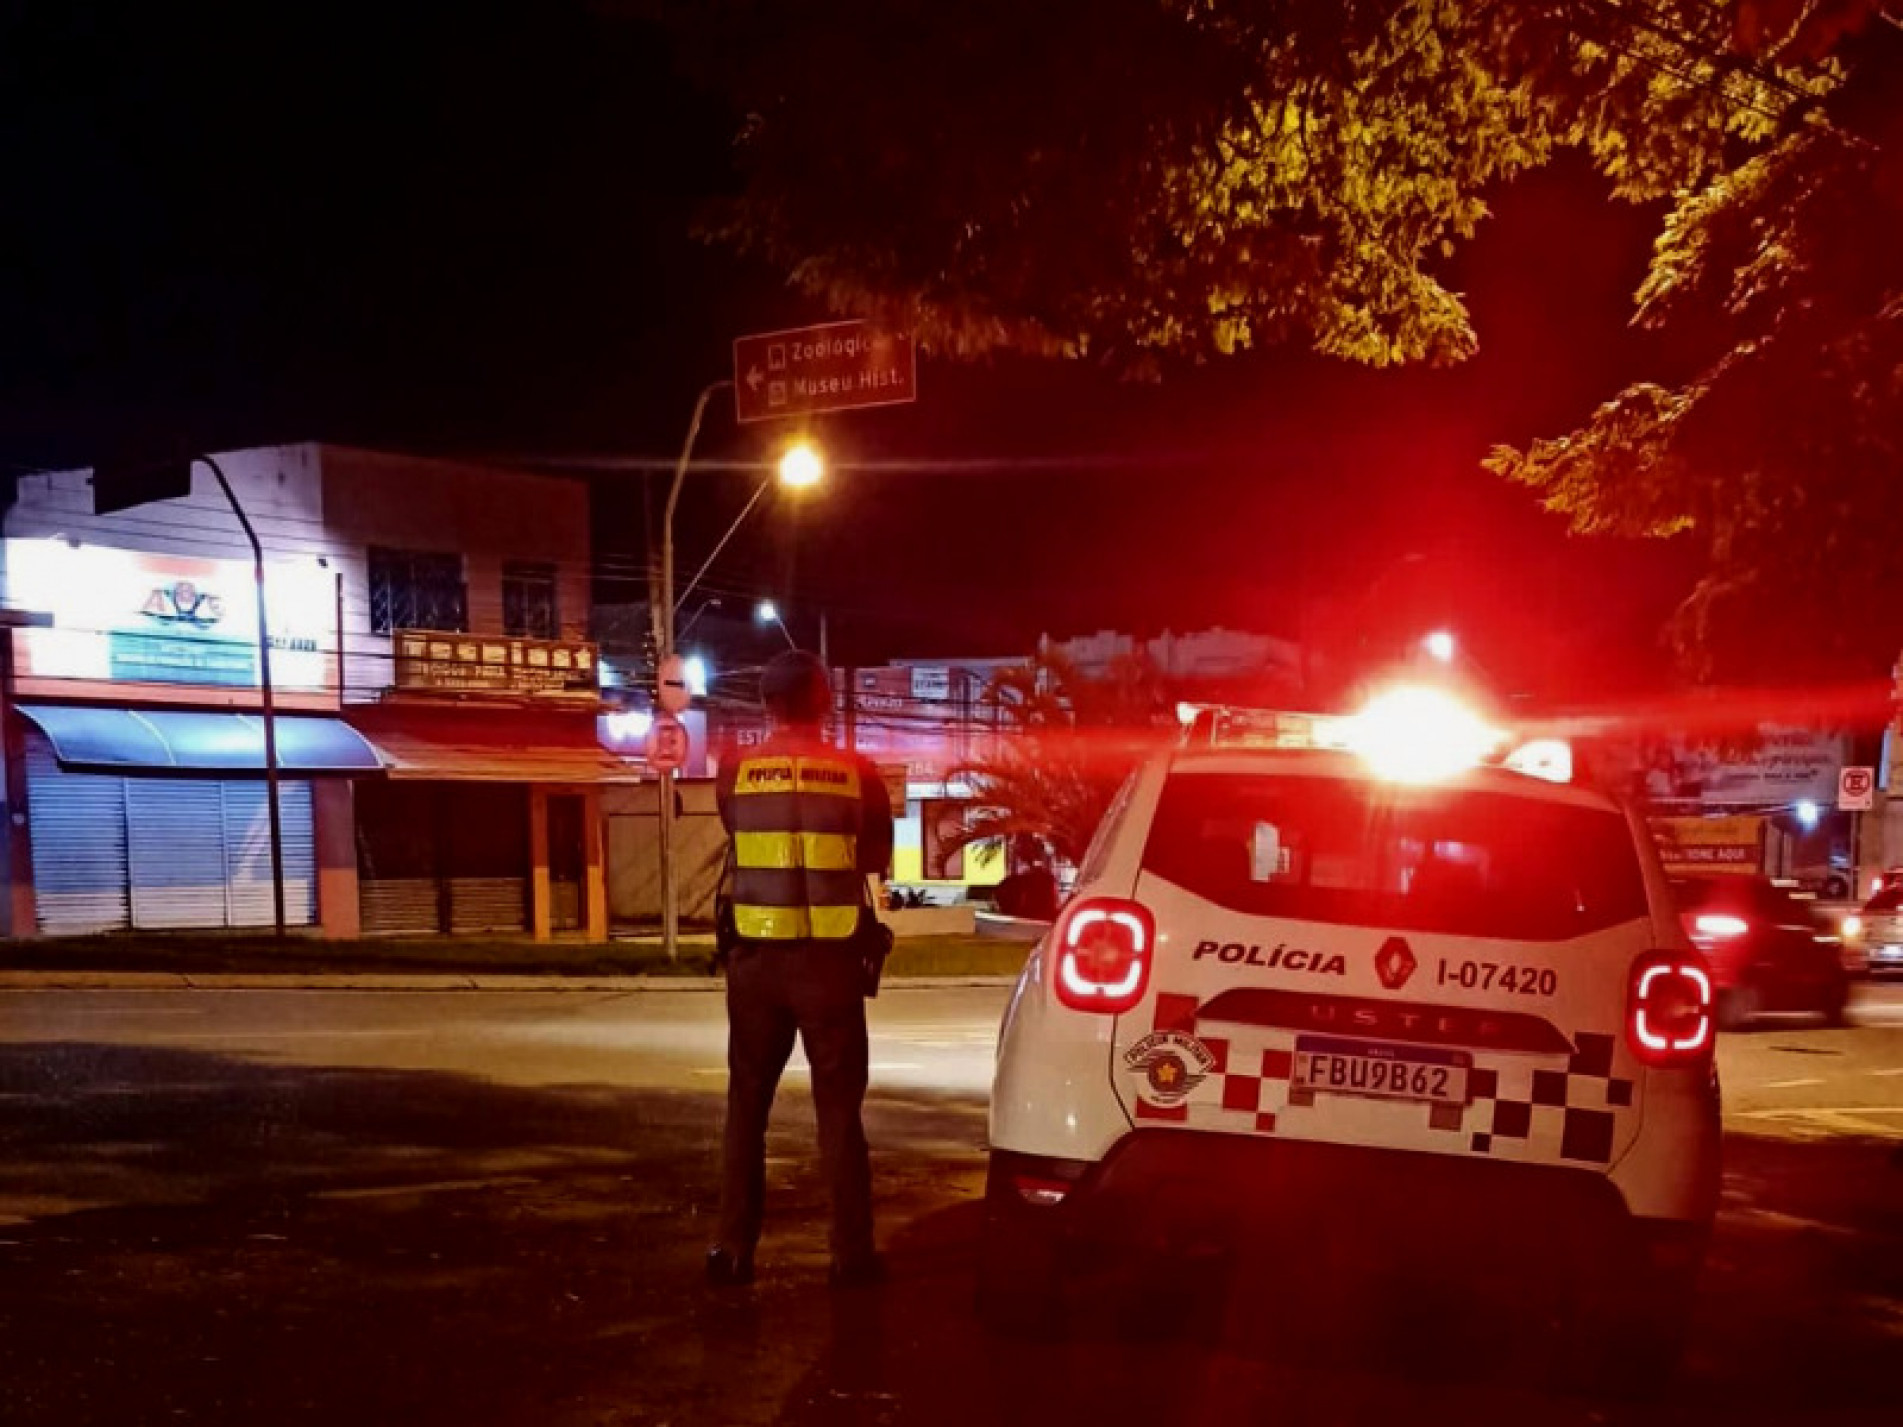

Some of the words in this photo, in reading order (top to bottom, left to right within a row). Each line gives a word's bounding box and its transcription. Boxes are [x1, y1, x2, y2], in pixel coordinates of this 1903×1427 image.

[791, 335, 873, 361] Zoológic
[1192, 940, 1346, 976] POLÍCIA
[1436, 957, 1558, 997] I-07420
[1309, 1055, 1449, 1097] FBU9B62
